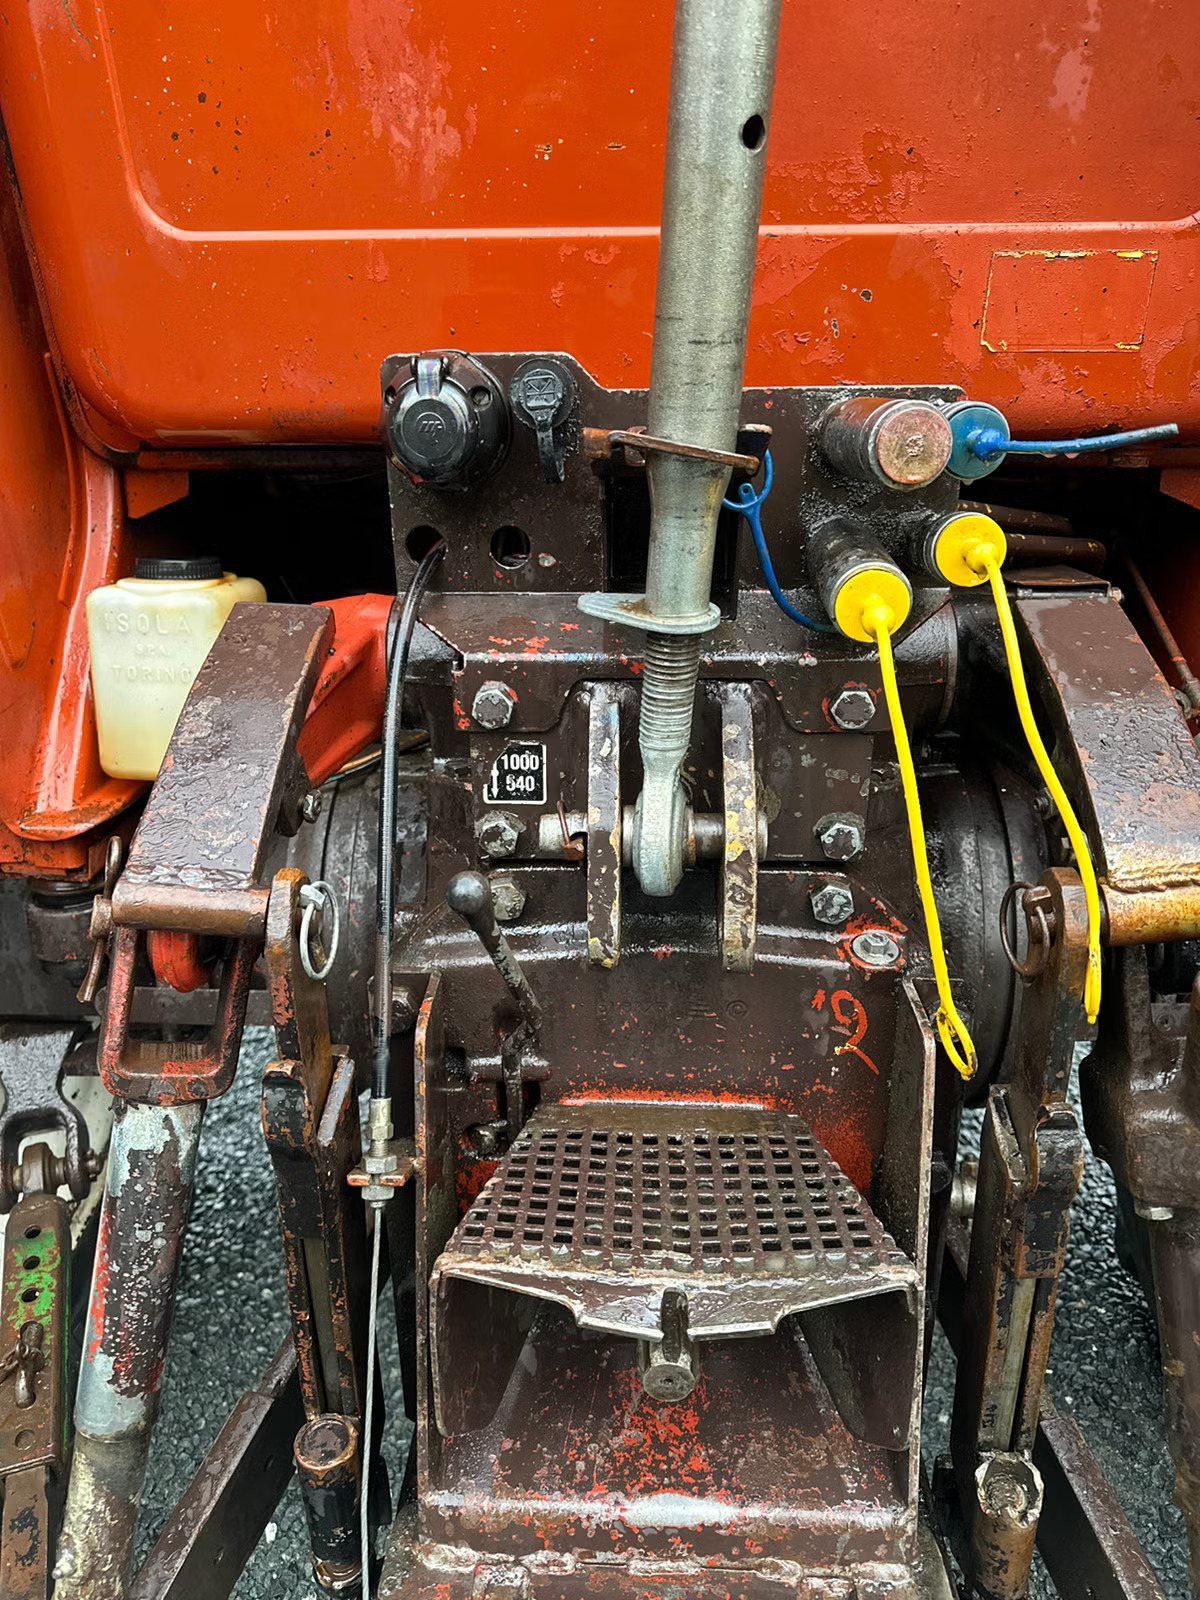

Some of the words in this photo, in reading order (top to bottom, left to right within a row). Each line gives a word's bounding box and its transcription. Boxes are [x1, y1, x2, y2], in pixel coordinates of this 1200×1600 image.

[103, 612, 192, 634] ISOLA
[111, 664, 192, 683] TORINO
[501, 753, 540, 771] 1000
[505, 774, 535, 792] 540
